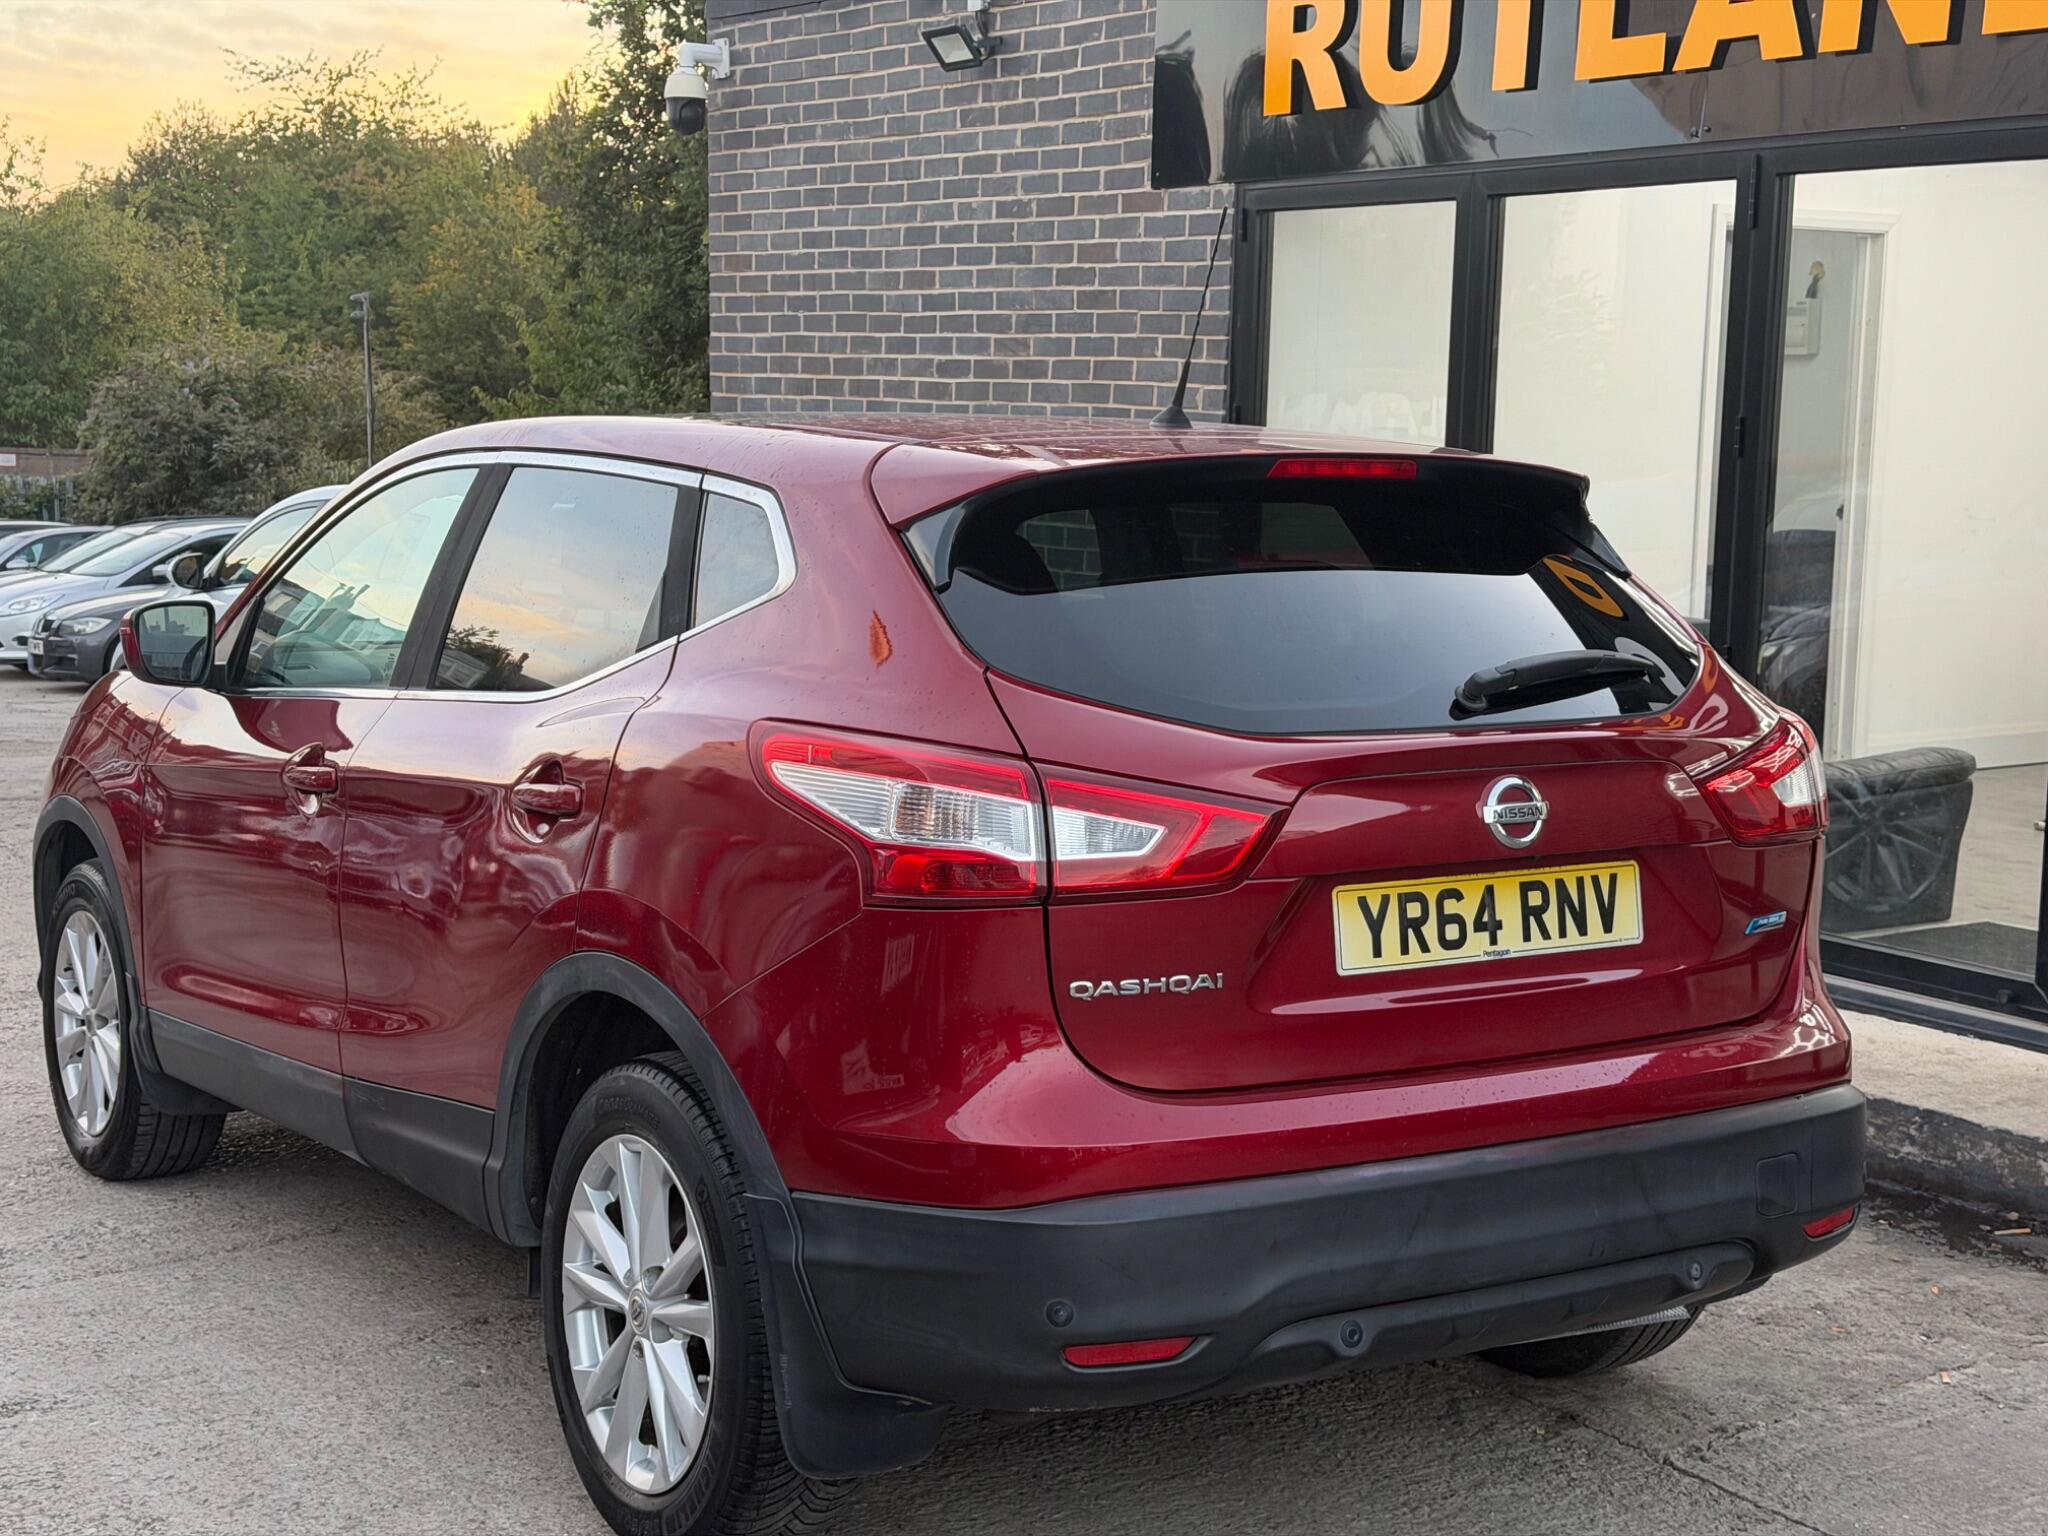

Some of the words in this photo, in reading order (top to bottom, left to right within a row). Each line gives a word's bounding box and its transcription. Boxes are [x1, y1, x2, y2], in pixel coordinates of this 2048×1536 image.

[1493, 806, 1543, 820] NISSAN
[1356, 883, 1504, 959] YR64
[1518, 872, 1618, 944] RNV
[1482, 948, 1512, 959] Pentagon
